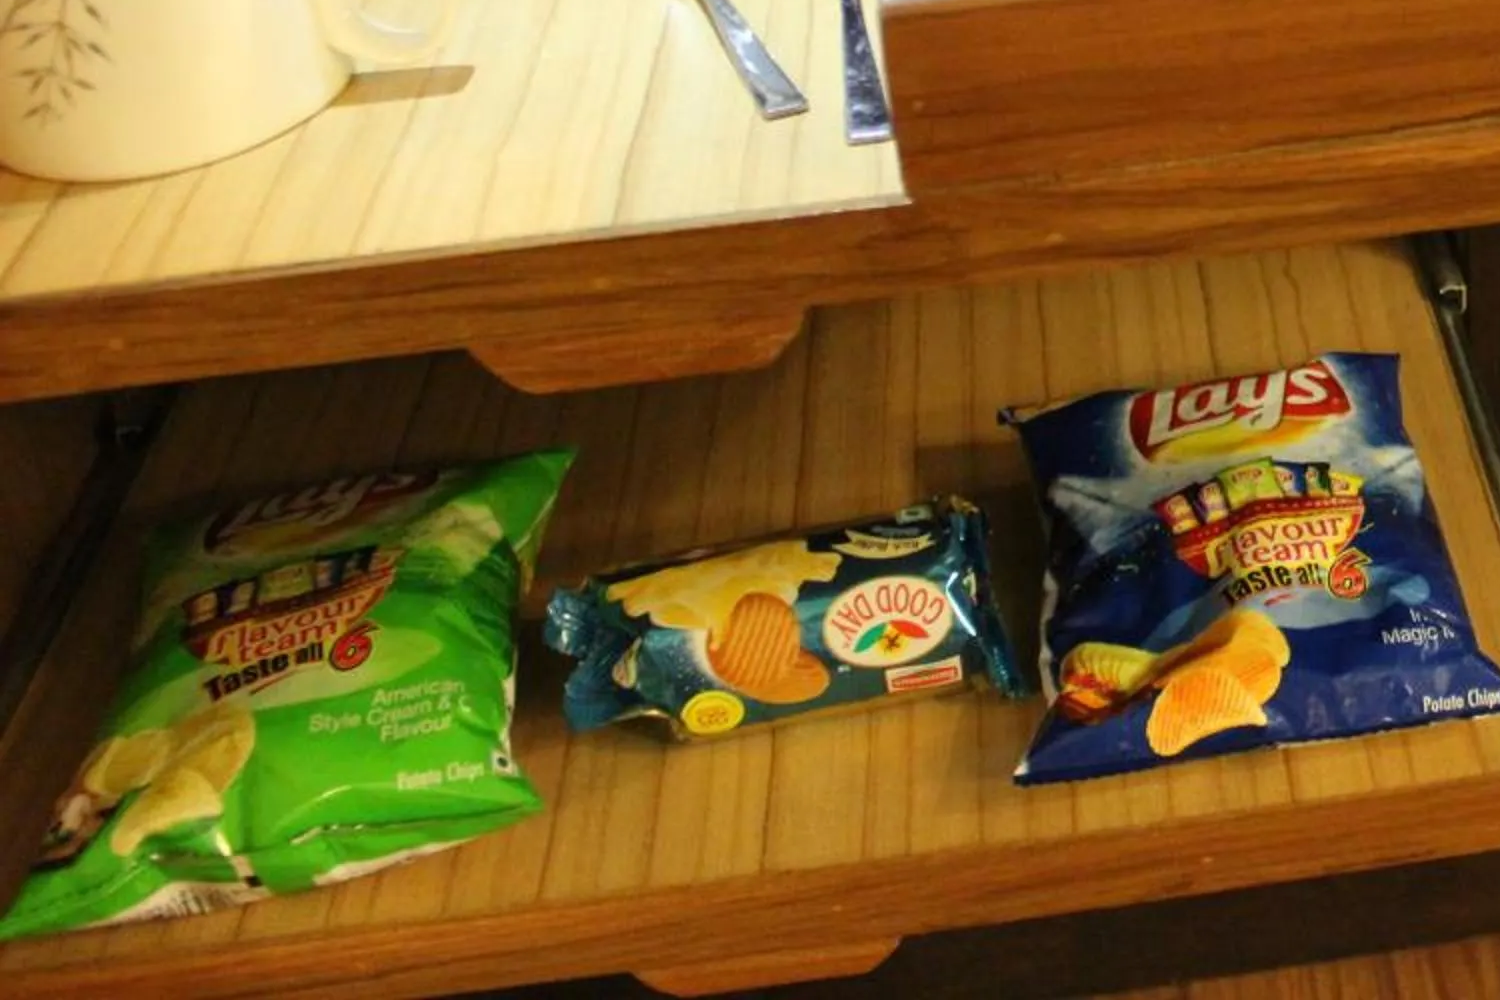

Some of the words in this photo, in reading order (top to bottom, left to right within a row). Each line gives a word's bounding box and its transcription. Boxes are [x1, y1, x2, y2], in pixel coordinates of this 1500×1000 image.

[1326, 547, 1372, 600] 6
[831, 593, 874, 642] DAY
[876, 583, 945, 626] GOOD
[1381, 623, 1439, 648] Magic
[203, 650, 291, 701] Taste
[294, 642, 324, 666] all
[328, 618, 382, 672] 6
[370, 679, 466, 707] American
[1423, 692, 1465, 713] Potato
[309, 710, 362, 735] Style
[366, 699, 433, 726] Cream
[437, 696, 452, 710] &
[379, 713, 453, 743] Flavour
